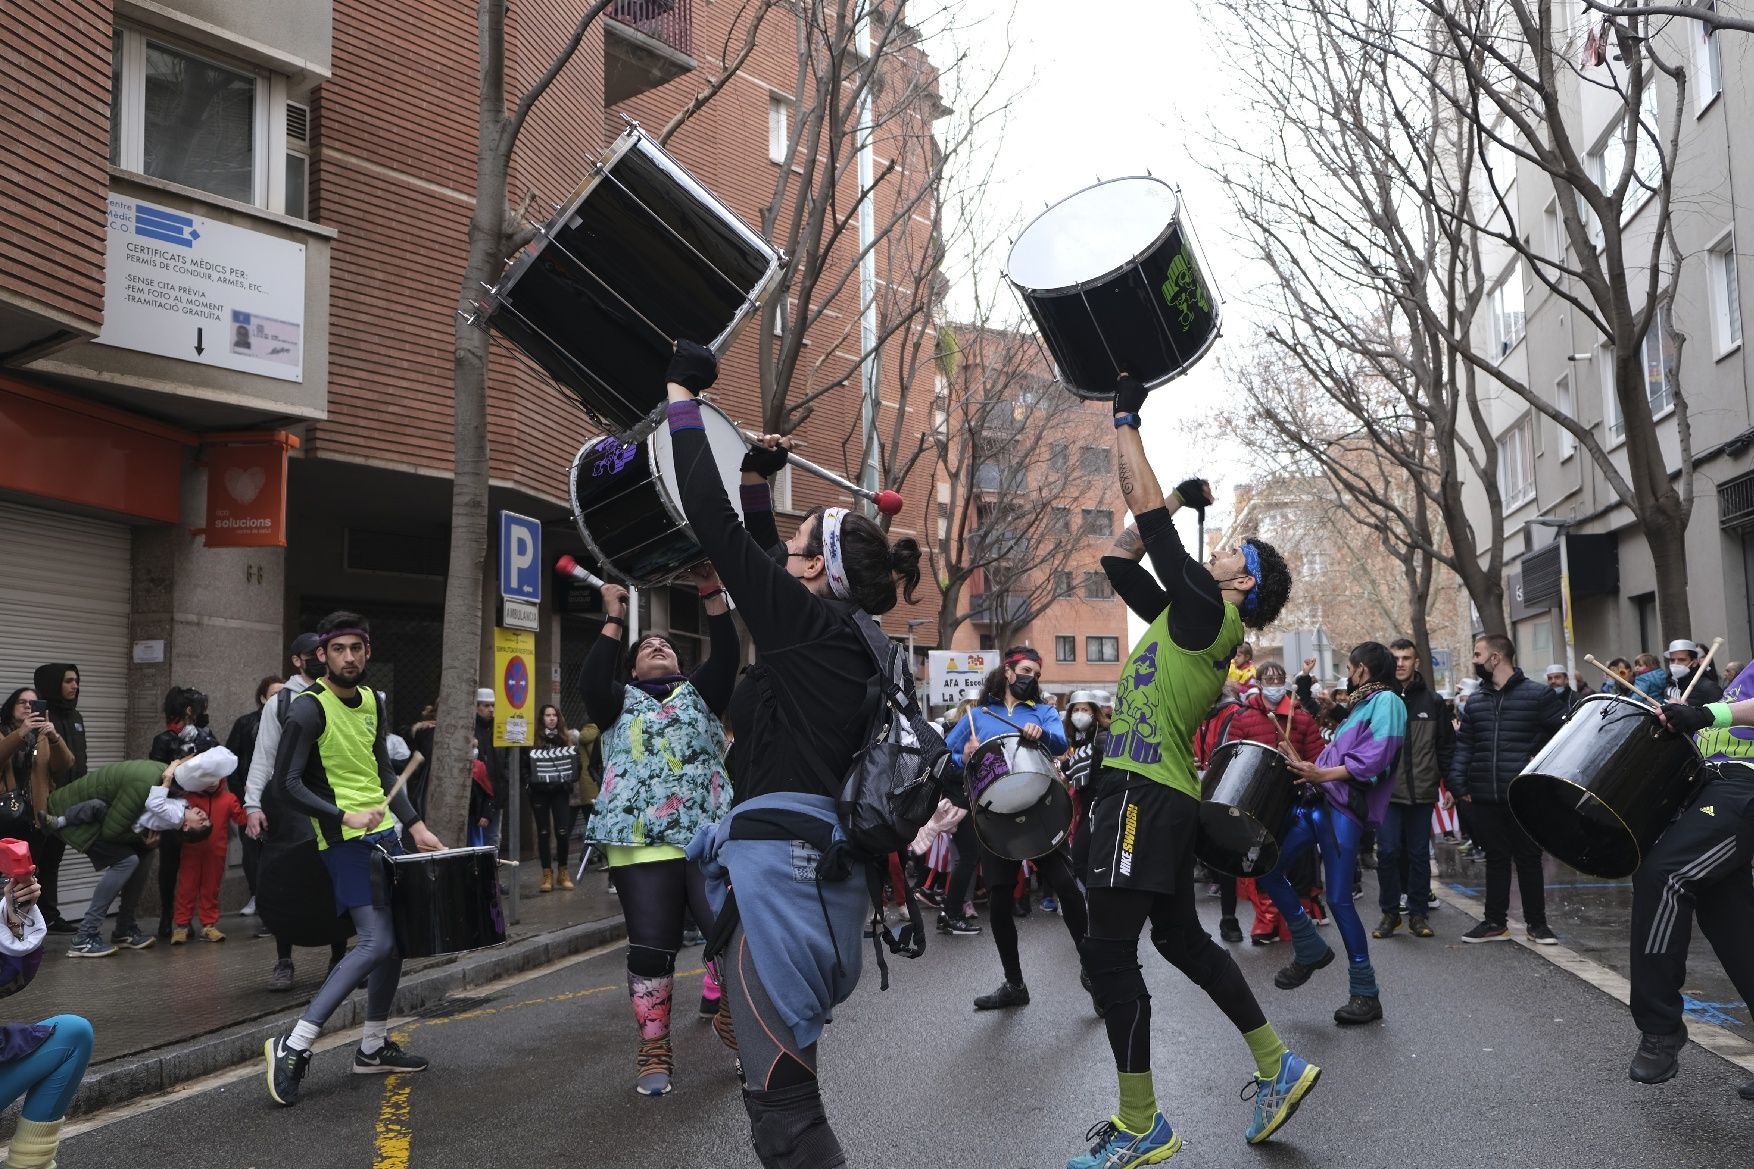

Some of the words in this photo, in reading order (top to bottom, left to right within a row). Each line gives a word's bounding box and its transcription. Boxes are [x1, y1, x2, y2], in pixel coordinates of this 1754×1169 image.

[108, 200, 132, 211] entre
[126, 242, 187, 265] CERTIFICATS
[190, 257, 227, 274] MÈDICS
[229, 267, 248, 279] PER:
[126, 253, 157, 267] PERMÍS
[159, 261, 170, 271] DE
[173, 264, 214, 282] CONDUIR,
[216, 275, 246, 290] ARMES,
[124, 273, 155, 286] -SENSE
[157, 281, 176, 291] CITA
[178, 285, 206, 298] PRÈVIA
[124, 284, 145, 295] -FEM
[147, 288, 171, 300] FOTO
[173, 294, 184, 304] AL
[185, 299, 224, 312] MOMENT
[124, 294, 179, 312] -TRAMITACIÓ
[181, 306, 221, 321] GRATUÏTA
[215, 516, 272, 528] solucions
[510, 523, 534, 589] P
[944, 679, 959, 688] AFA
[964, 677, 984, 687] Escol
[942, 692, 954, 703] La
[1122, 803, 1139, 853] SWOOSH
[1119, 850, 1133, 877] NIKE
